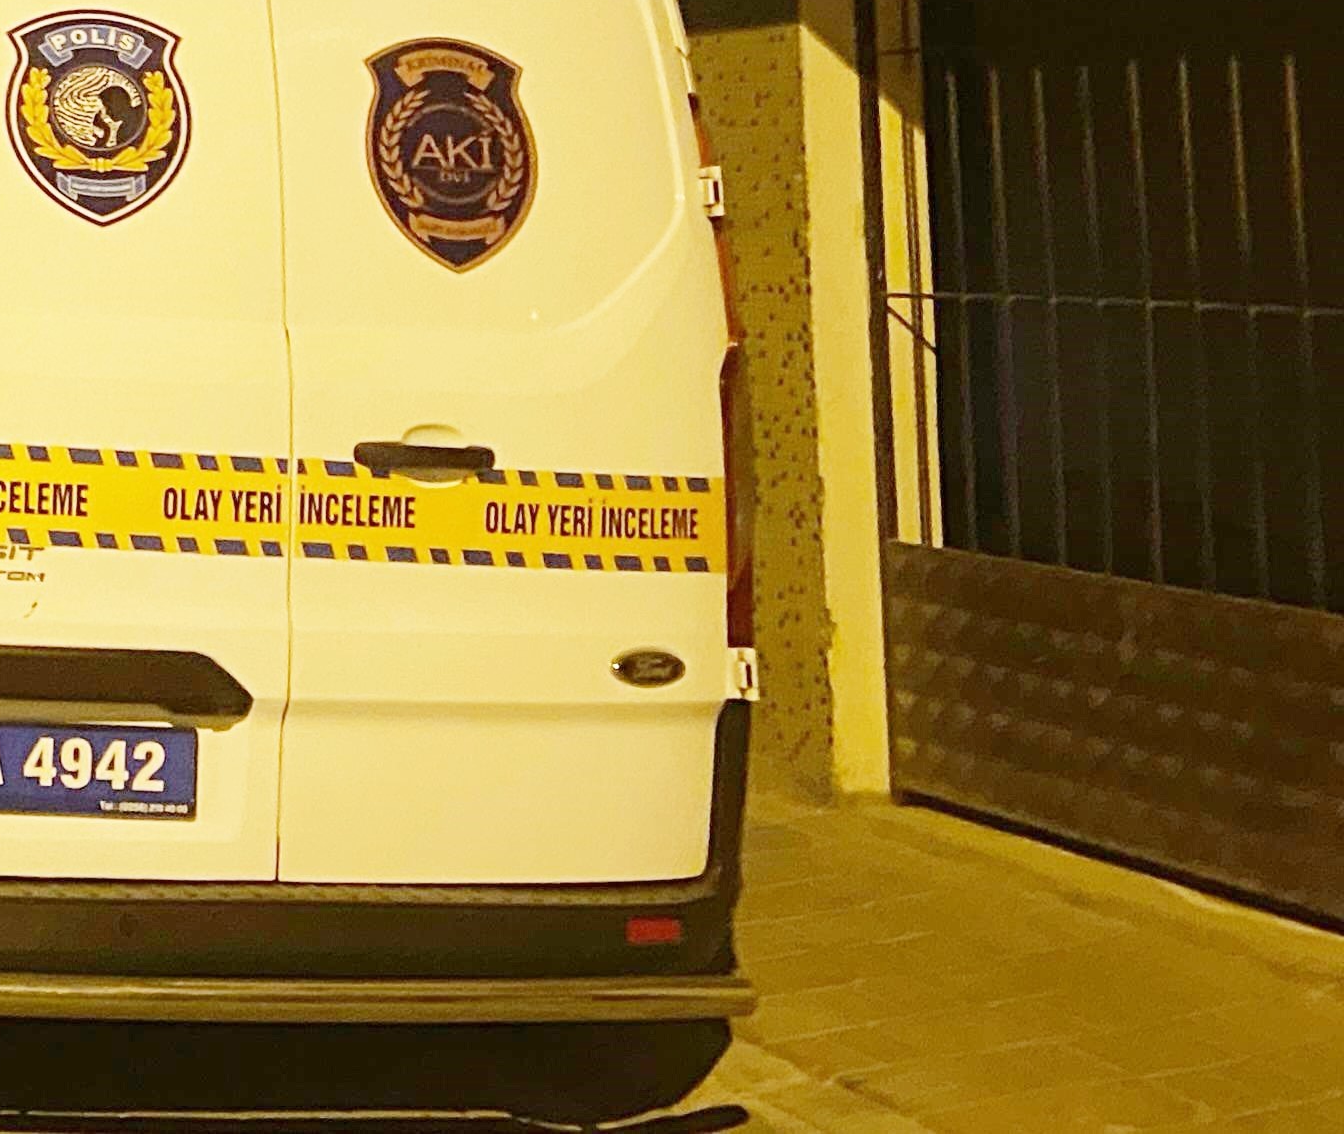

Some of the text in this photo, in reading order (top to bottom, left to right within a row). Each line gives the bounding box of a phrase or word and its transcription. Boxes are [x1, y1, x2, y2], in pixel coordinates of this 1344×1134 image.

[163, 484, 417, 529] OLAY YERİ İNCELEME
[485, 497, 699, 541] OLAY YERİ İNCELEME
[23, 736, 167, 792] 4942
